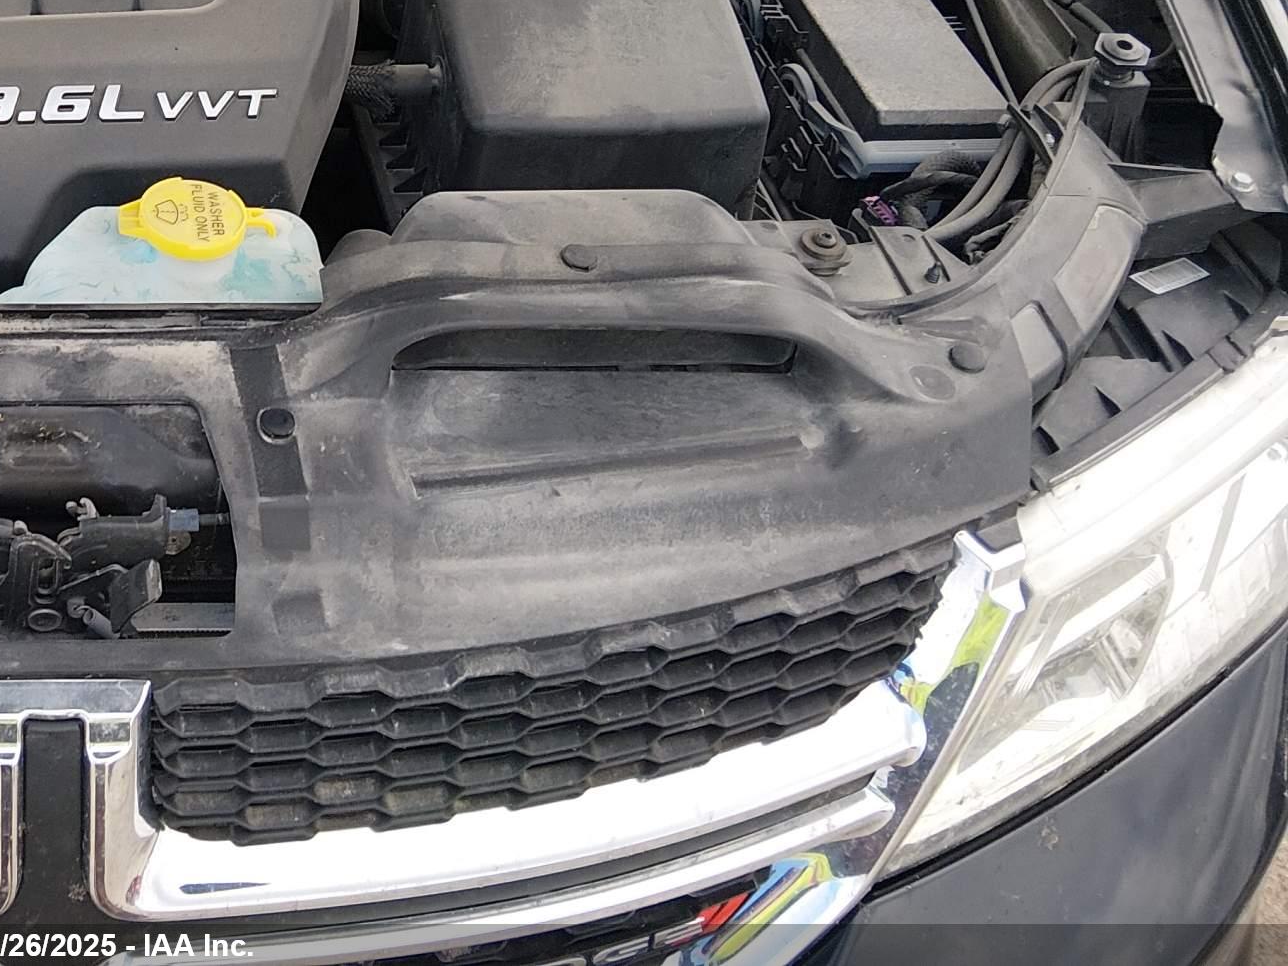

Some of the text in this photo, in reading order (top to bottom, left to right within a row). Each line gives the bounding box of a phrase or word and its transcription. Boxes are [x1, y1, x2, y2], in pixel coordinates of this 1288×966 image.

[156, 88, 279, 121] VVT
[190, 183, 211, 243] FLUID ONLY
[207, 191, 226, 237] WASHER
